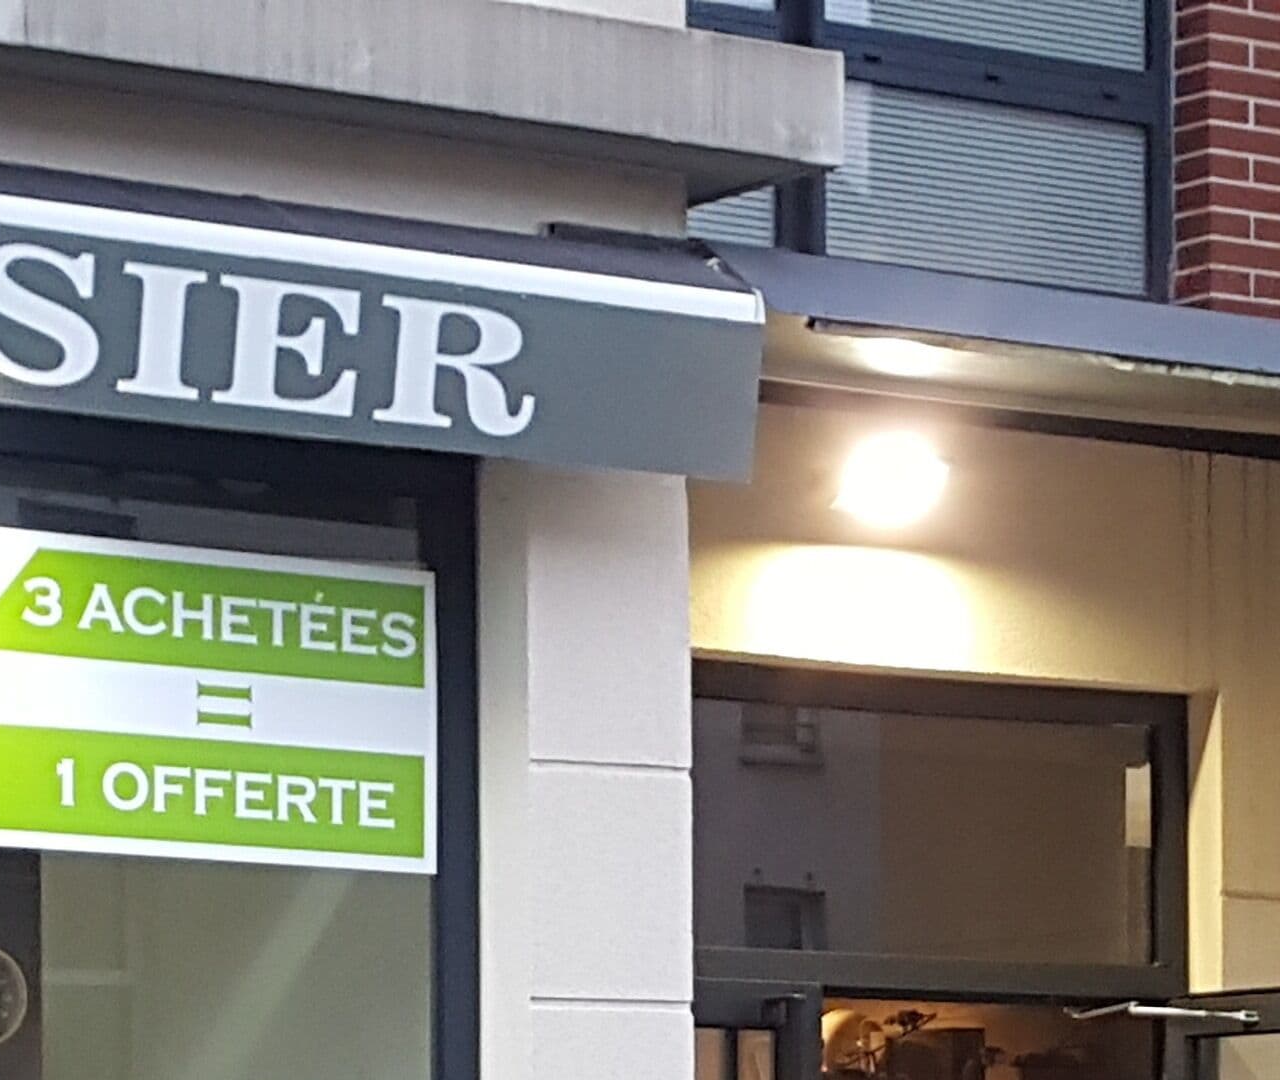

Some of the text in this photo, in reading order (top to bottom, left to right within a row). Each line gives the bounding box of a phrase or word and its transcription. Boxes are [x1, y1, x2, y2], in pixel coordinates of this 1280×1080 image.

[21, 576, 418, 659] 3 ACHETÉES
[55, 757, 396, 828] 1 OFFERTE
